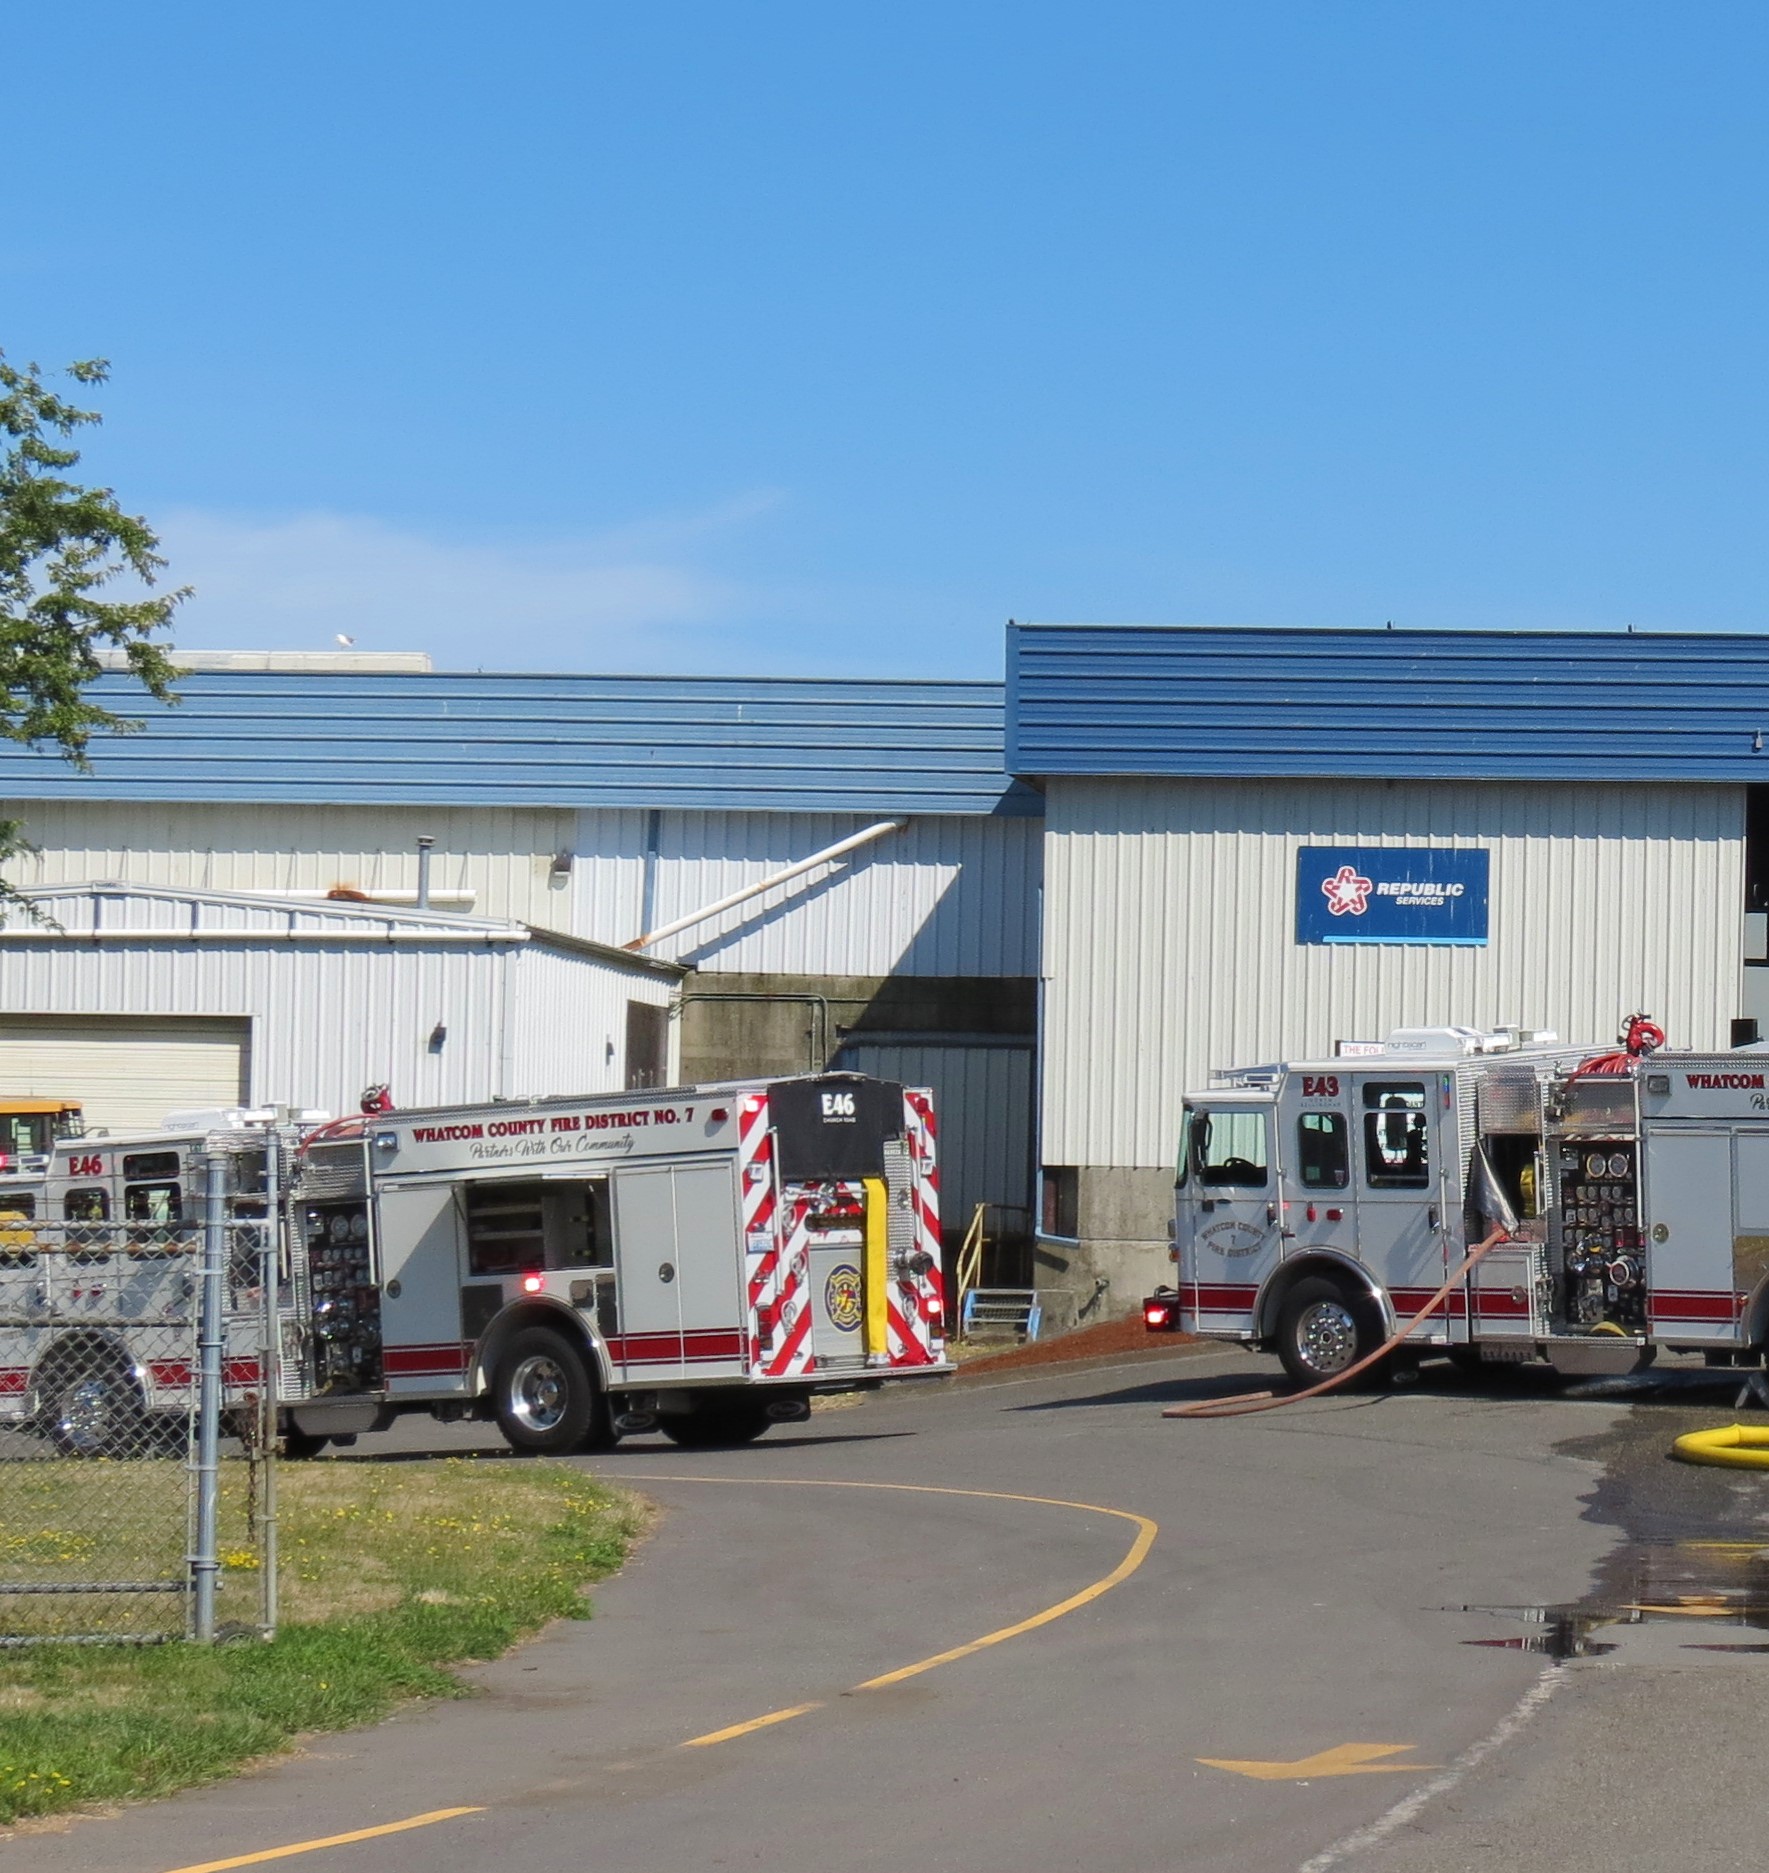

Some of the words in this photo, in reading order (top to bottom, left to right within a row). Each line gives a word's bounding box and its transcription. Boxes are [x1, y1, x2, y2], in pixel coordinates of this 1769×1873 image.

[1377, 882, 1464, 897] REPUBLIC
[1395, 896, 1444, 906] SERVICES
[1343, 1045, 1361, 1055] THE
[1302, 1075, 1339, 1097] E43
[1686, 1074, 1765, 1089] WHATCOM
[821, 1093, 856, 1116] E46
[412, 1123, 484, 1143] WHATCOM
[487, 1118, 547, 1138] COUNTY
[550, 1115, 581, 1133] FIRE
[584, 1111, 650, 1130] DISTRICT
[653, 1108, 681, 1125] NO.
[685, 1107, 694, 1122] 7
[470, 1141, 513, 1159] Partners
[515, 1139, 546, 1157] With
[550, 1136, 571, 1154] Our
[575, 1132, 636, 1154] Community
[69, 1153, 103, 1176] E46
[1201, 1221, 1236, 1240] WHATCOM
[1237, 1221, 1267, 1240] COUNTY
[1231, 1234, 1236, 1245] 7
